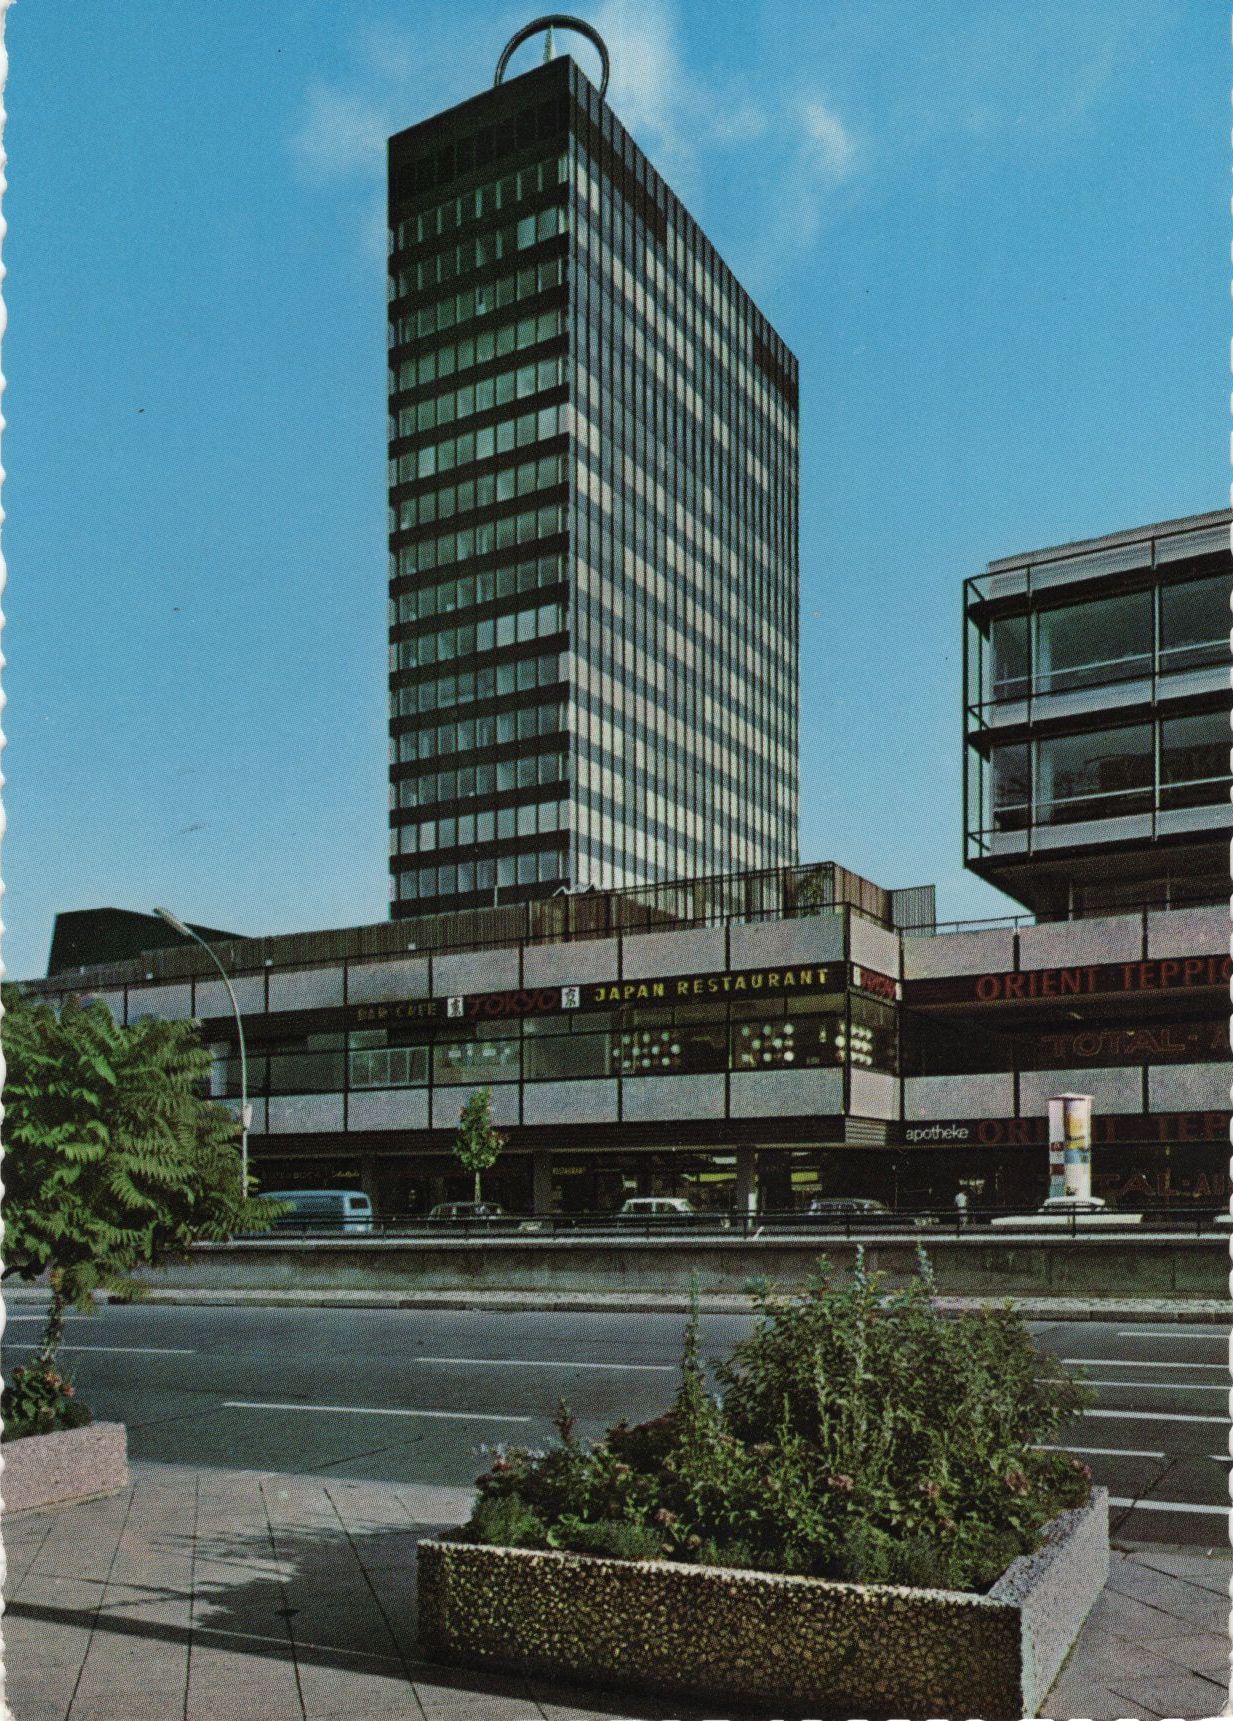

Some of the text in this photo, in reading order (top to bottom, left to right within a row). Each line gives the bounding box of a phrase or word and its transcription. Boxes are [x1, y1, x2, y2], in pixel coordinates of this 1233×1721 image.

[595, 968, 829, 1002] JAPAN RESTAURANT
[975, 967, 1100, 1001] ORIENT
[467, 989, 559, 1018] TOKYO
[906, 1124, 970, 1141] apotheke
